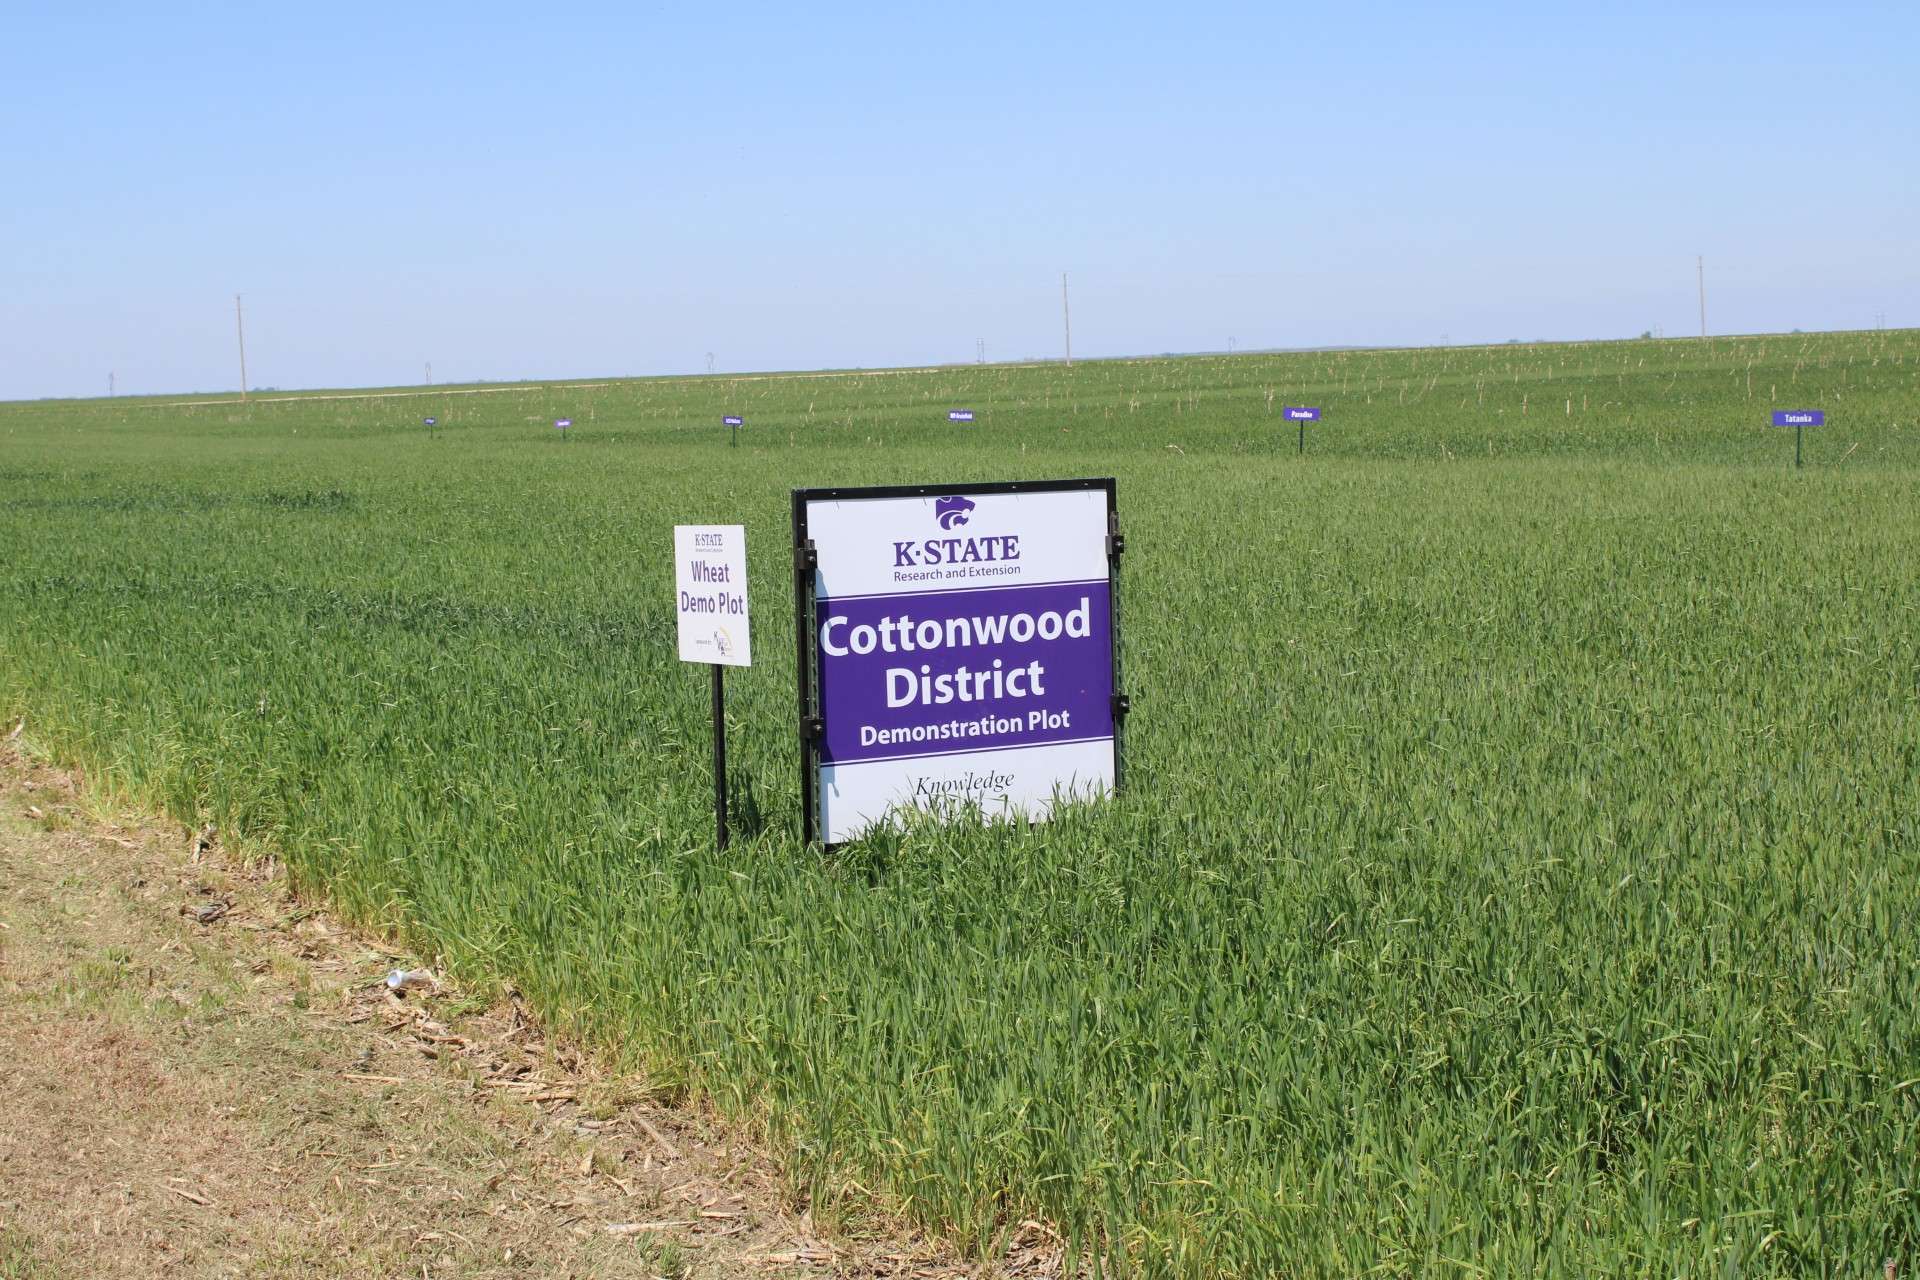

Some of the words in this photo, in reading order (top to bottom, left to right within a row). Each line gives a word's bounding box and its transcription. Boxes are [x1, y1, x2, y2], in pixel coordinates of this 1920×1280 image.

[1785, 413, 1812, 423] Tatanka
[691, 560, 730, 583] Wheat
[894, 569, 942, 582] Research
[945, 567, 966, 579] and
[969, 565, 1021, 577] Extension
[681, 590, 715, 613] Demo
[719, 592, 744, 615] Plot
[820, 597, 1091, 657] Cottonwood
[886, 658, 1045, 708] District
[860, 714, 1023, 746] Demonstration
[1028, 709, 1070, 732] Plot
[916, 769, 1015, 795] Knowledge
